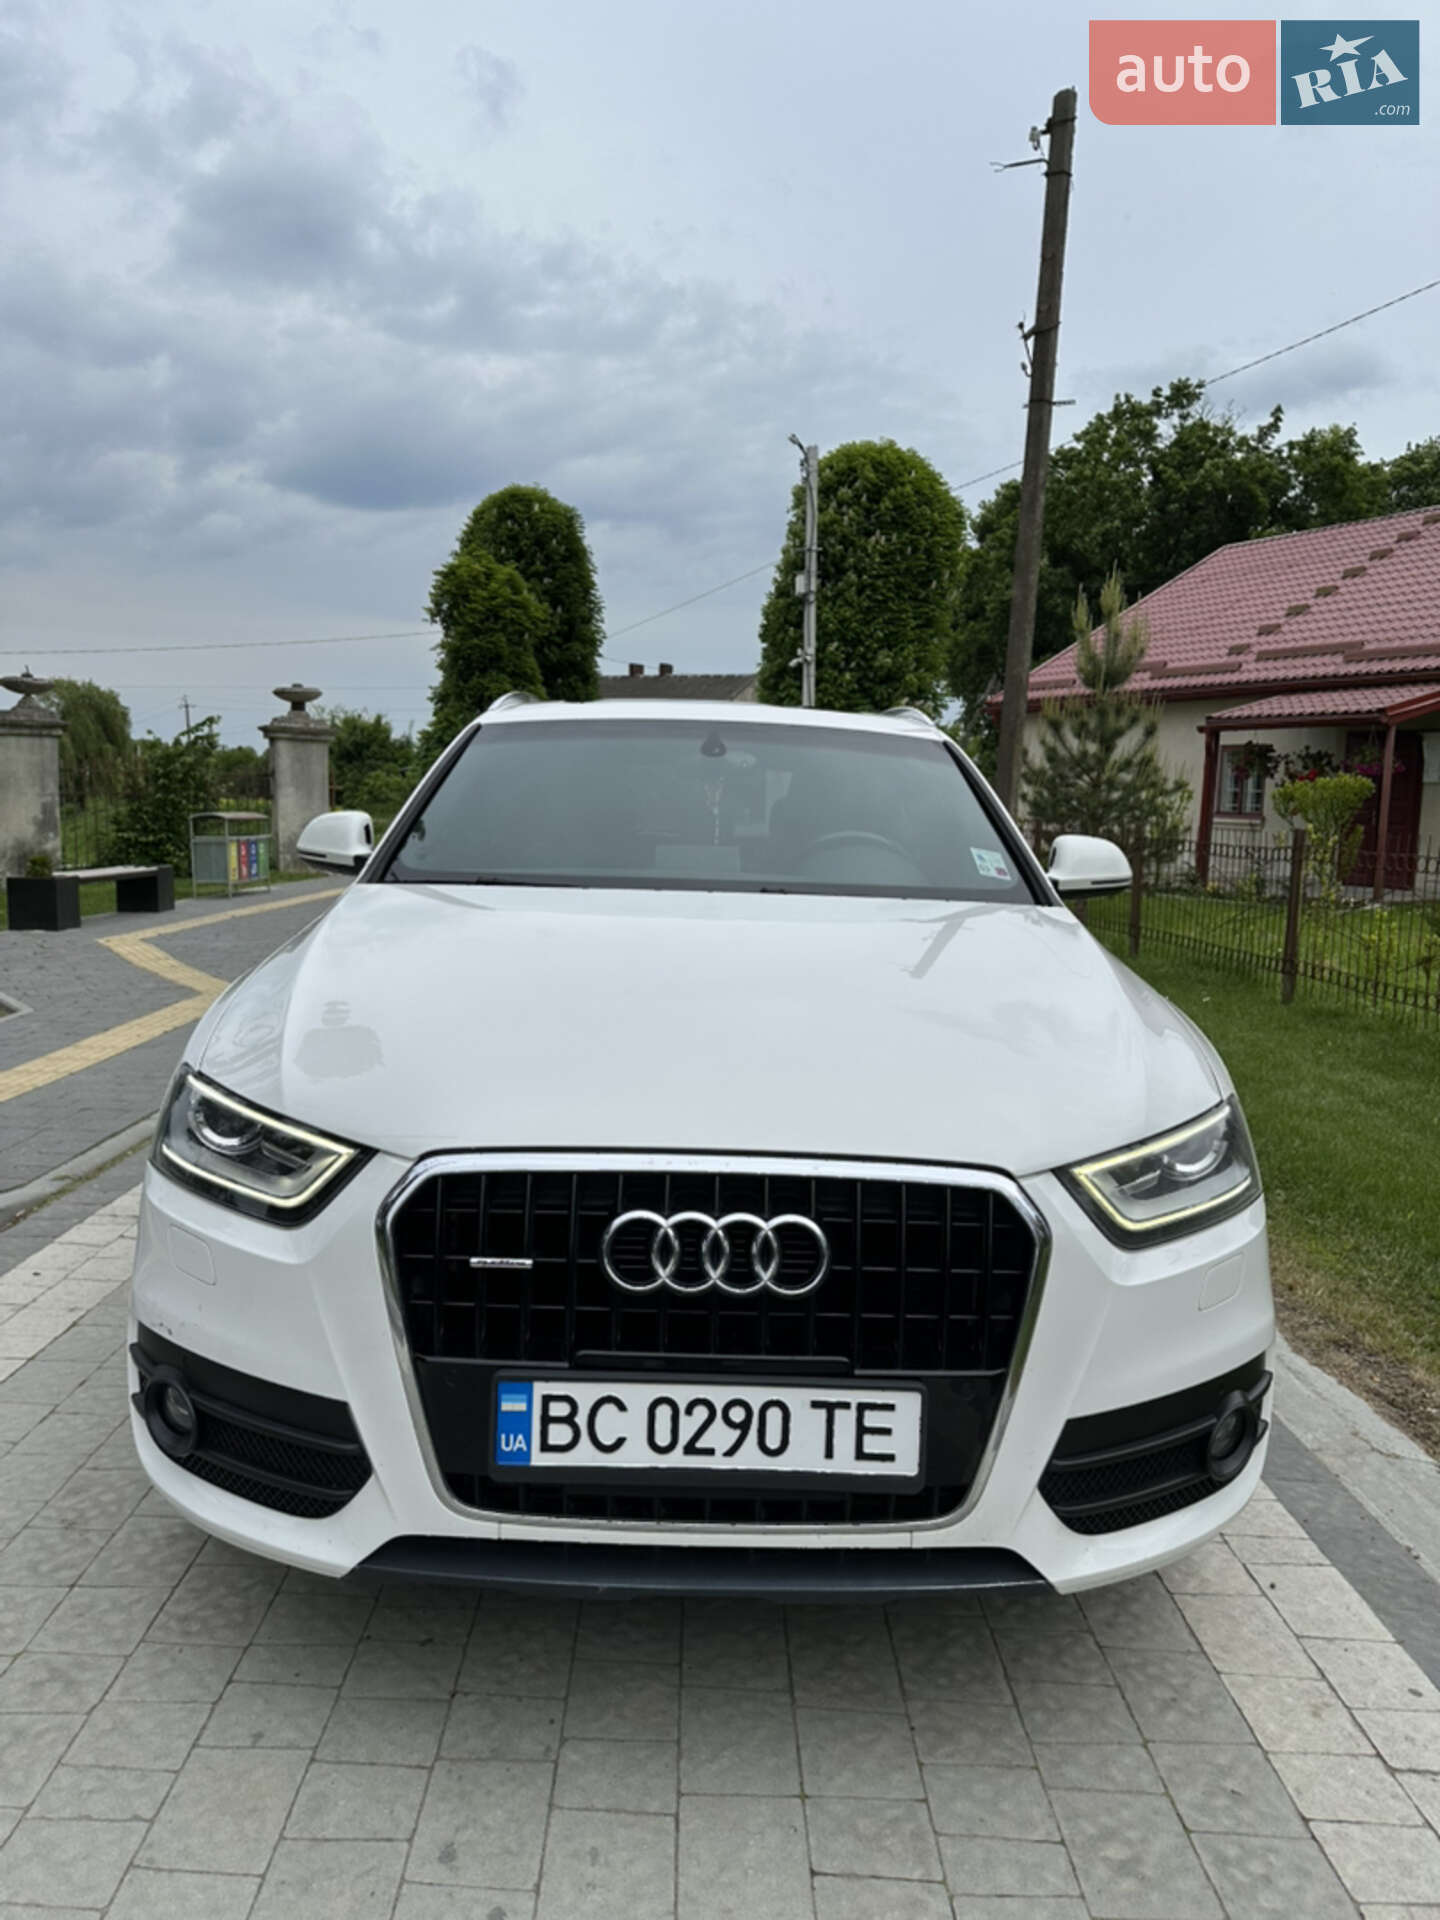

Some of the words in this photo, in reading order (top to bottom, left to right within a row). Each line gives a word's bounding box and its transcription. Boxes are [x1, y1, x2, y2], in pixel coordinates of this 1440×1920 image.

[500, 1433, 527, 1452] UA
[539, 1395, 627, 1453] BC
[646, 1396, 791, 1457] 0290
[810, 1400, 896, 1462] TE
